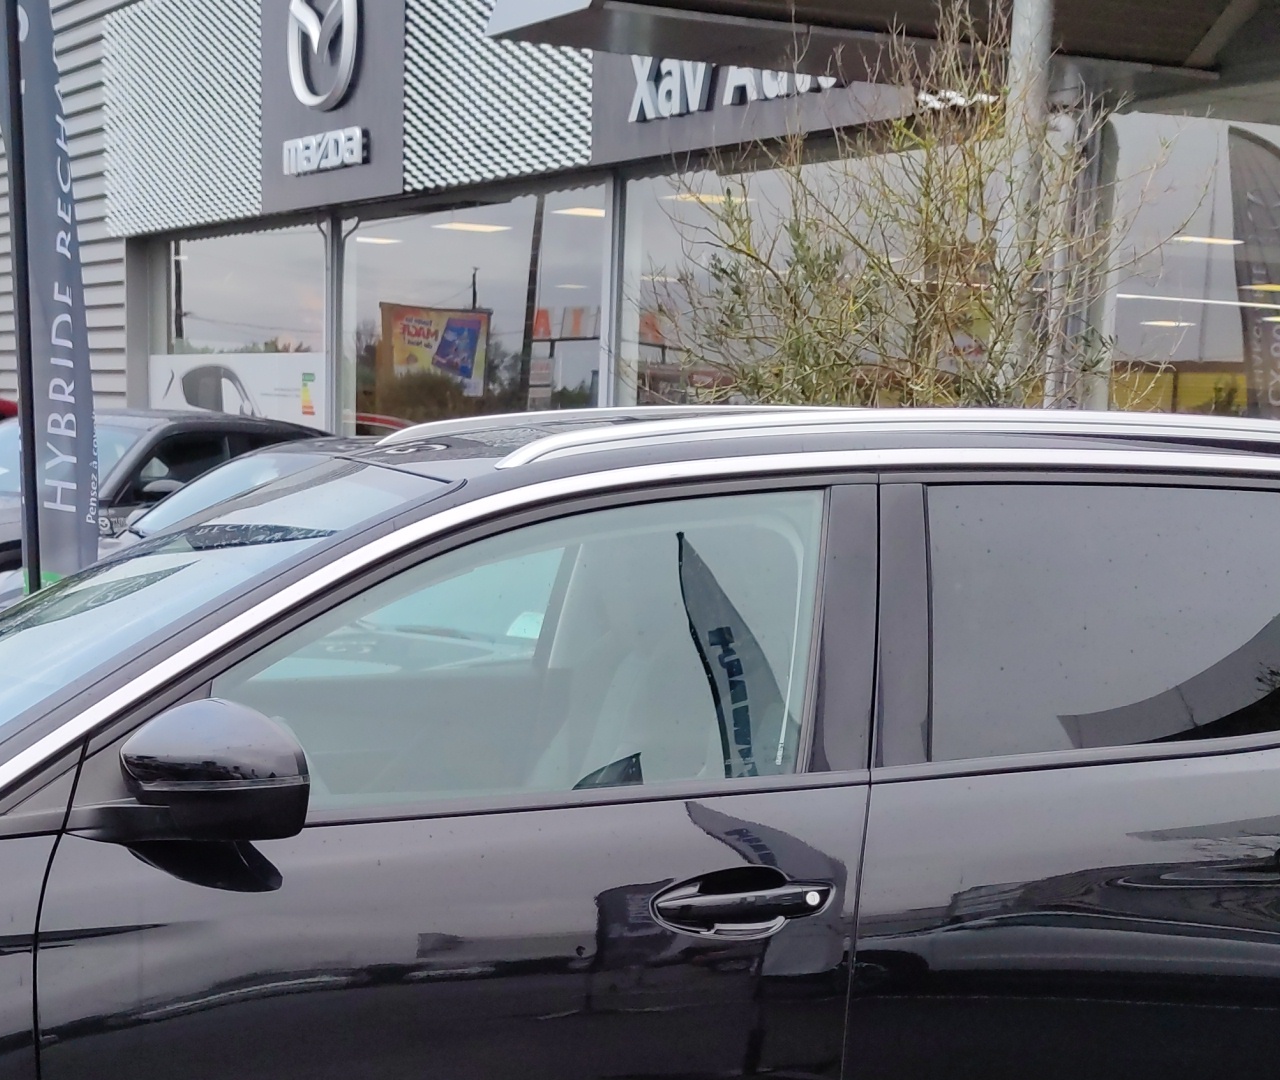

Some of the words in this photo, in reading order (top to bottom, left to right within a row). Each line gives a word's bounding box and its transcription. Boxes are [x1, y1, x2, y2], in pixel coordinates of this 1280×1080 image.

[628, 54, 708, 122] Xav
[282, 126, 363, 176] mazda
[43, 281, 77, 513] HYBRIDE
[86, 473, 98, 525] Pensez
